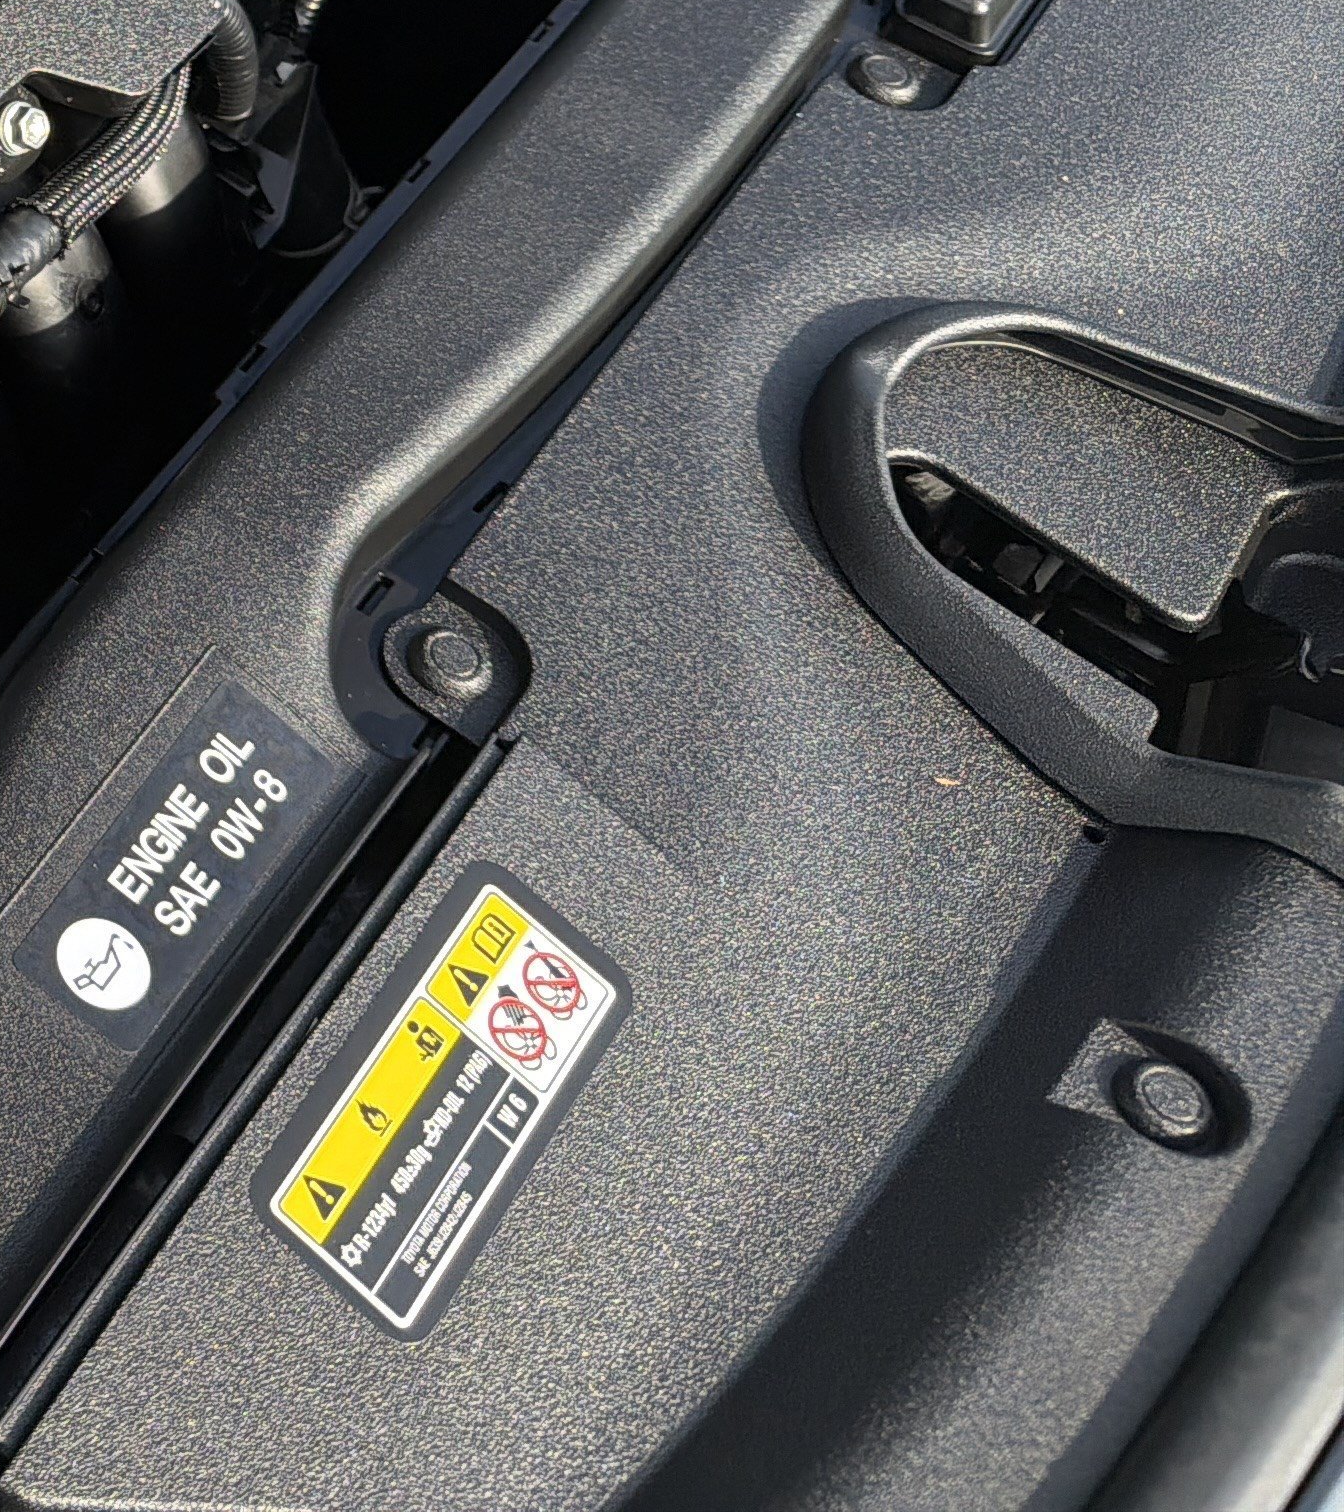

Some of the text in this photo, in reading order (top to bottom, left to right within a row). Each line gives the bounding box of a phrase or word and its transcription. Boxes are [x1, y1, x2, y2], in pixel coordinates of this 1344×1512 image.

[107, 732, 255, 905] ENGINE OIL
[154, 769, 288, 936] SAE 0W-8
[401, 1160, 473, 1265] TOYOTA MOTOR CORPORATION
[413, 1256, 431, 1278] SAE
